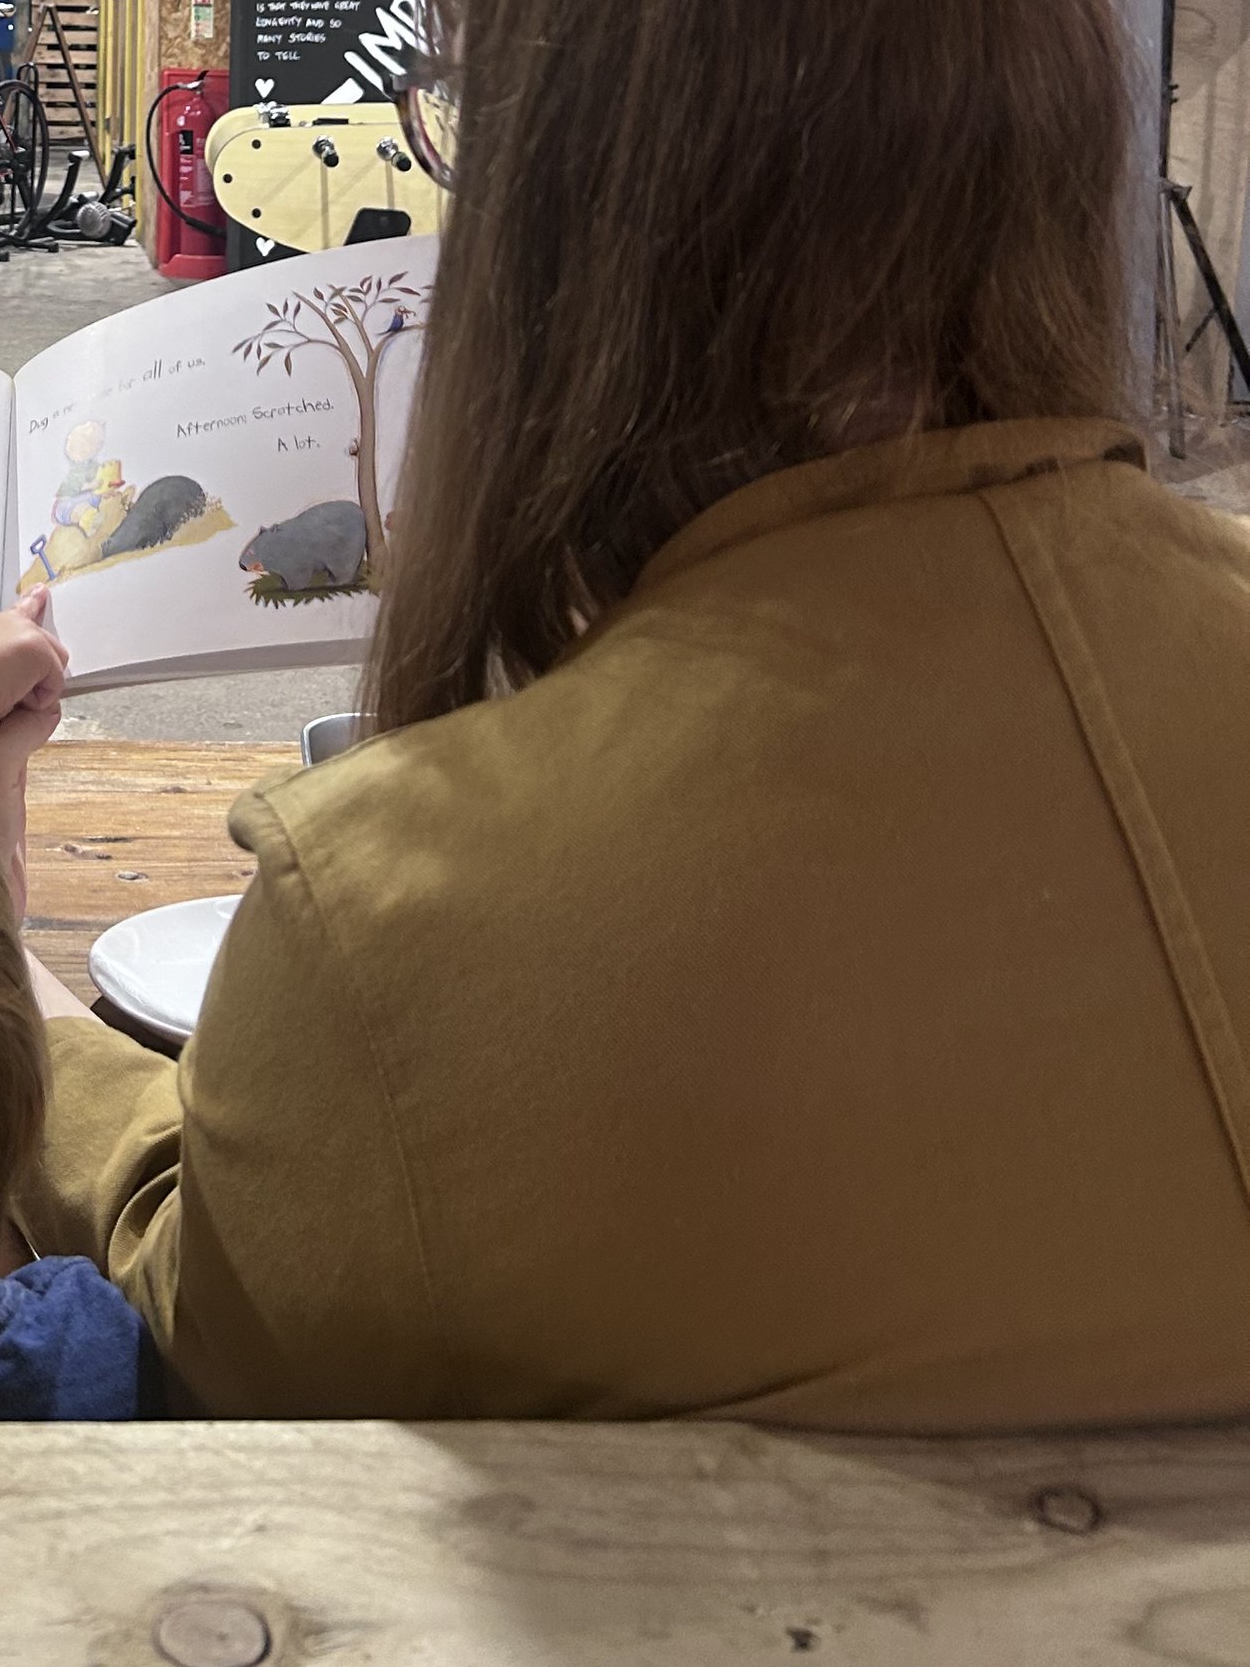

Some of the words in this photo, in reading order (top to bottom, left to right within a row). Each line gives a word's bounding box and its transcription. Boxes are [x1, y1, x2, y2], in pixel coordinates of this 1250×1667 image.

[256, 3, 265, 13] IS
[306, 19, 324, 28] AND
[329, 18, 342, 28] SO
[288, 32, 326, 43] STORIES
[257, 51, 270, 61] TO
[275, 51, 300, 61] TELL
[142, 359, 162, 381] all
[168, 360, 182, 375] of
[252, 398, 335, 420] Scratched.
[277, 438, 288, 452] A
[294, 435, 321, 450] lot.
